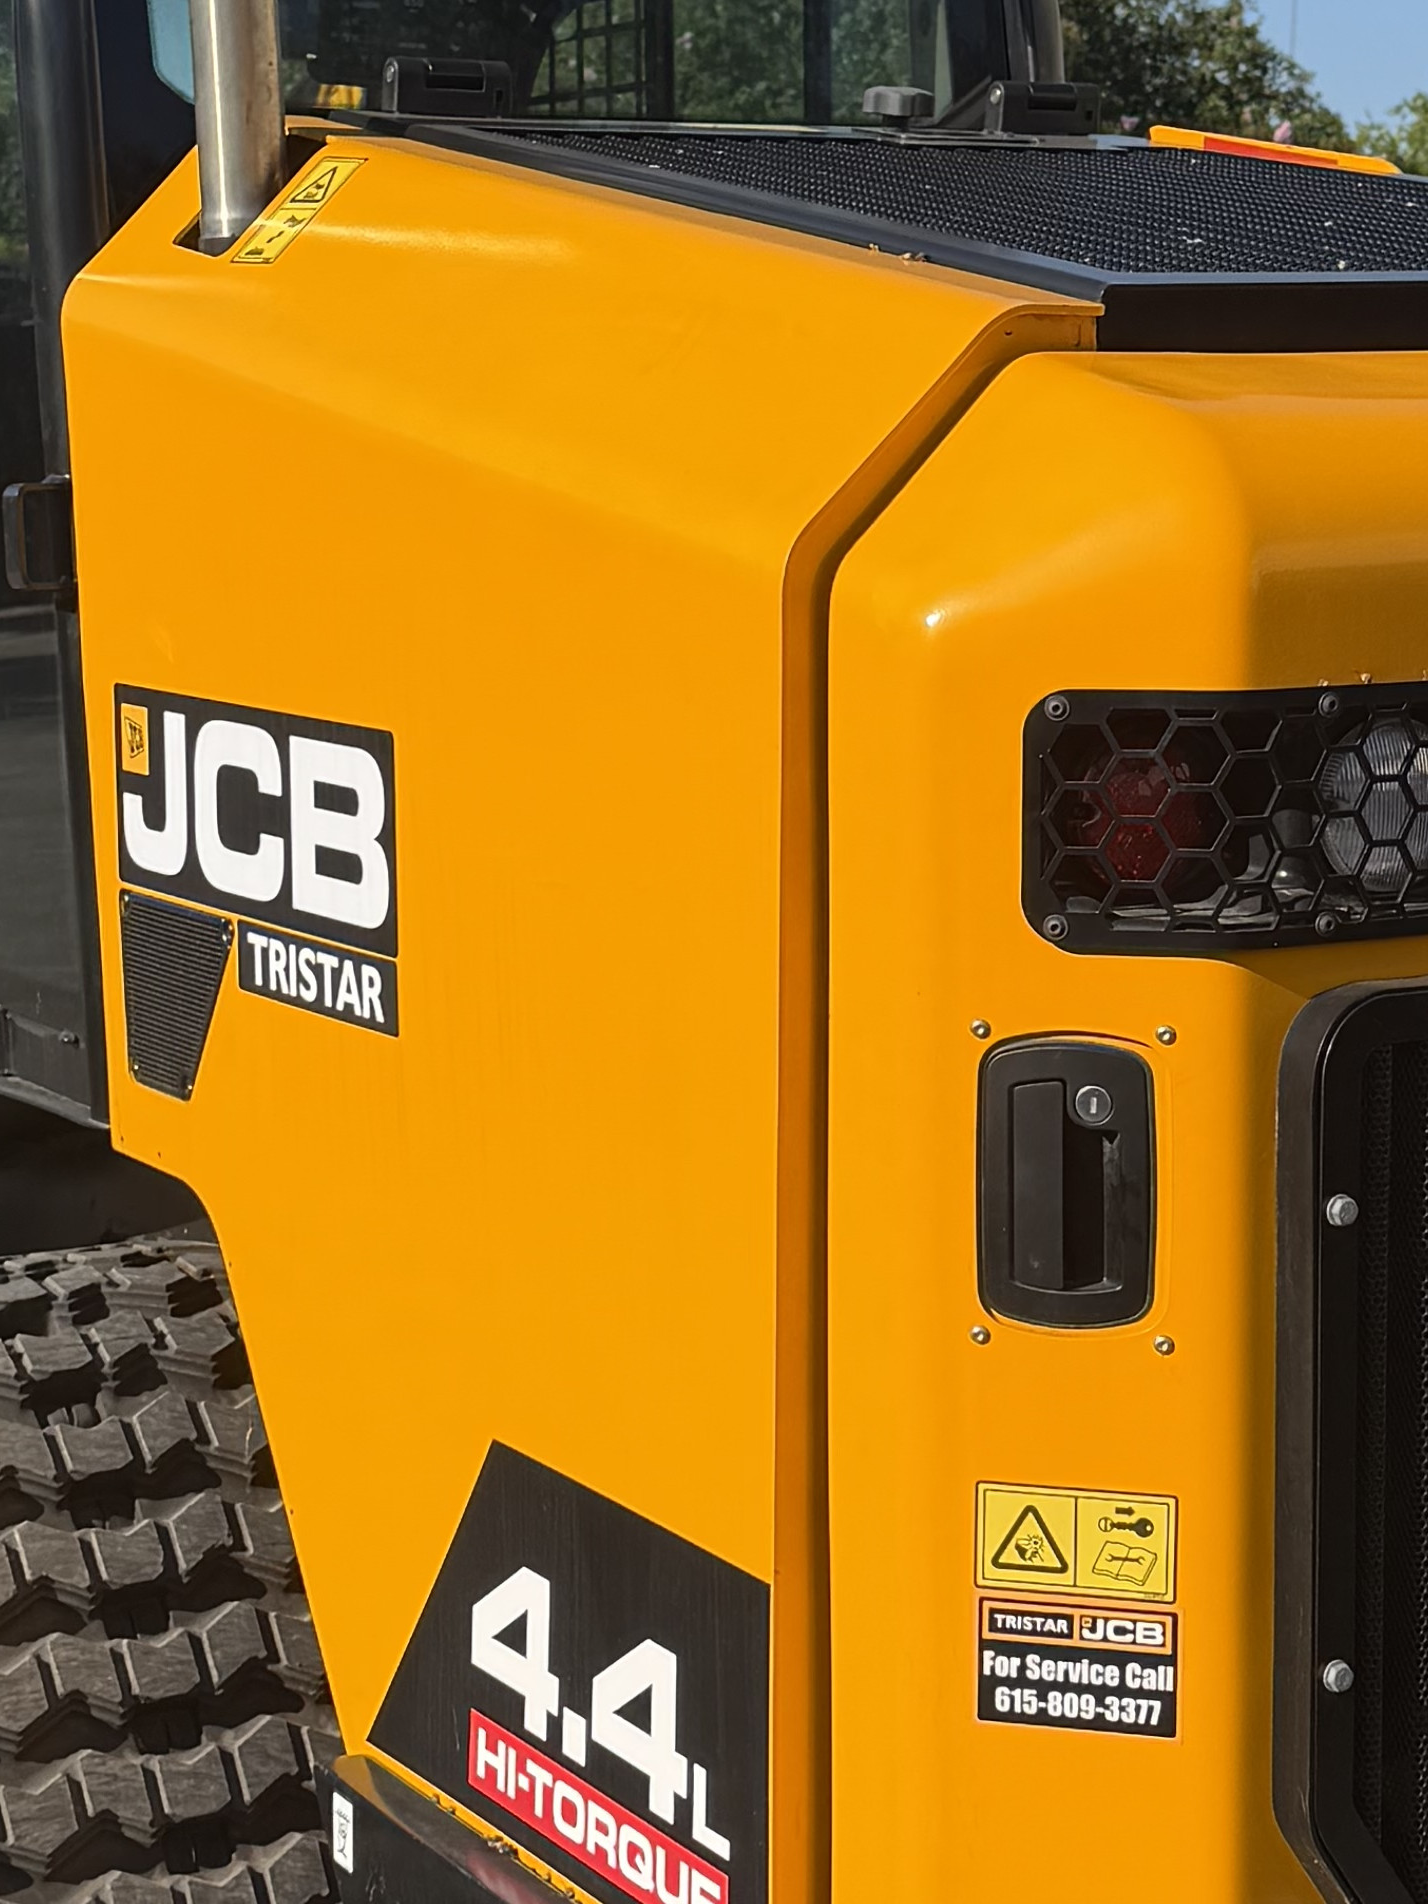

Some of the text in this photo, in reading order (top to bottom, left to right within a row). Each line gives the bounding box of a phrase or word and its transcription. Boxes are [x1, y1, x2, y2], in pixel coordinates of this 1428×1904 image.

[122, 709, 390, 930] JCB
[246, 932, 385, 1024] TRISTAR
[993, 1613, 1165, 1646] TRISTAR JCB
[982, 1649, 1174, 1692] For Service Call
[994, 1686, 1161, 1726] 615-809-3377
